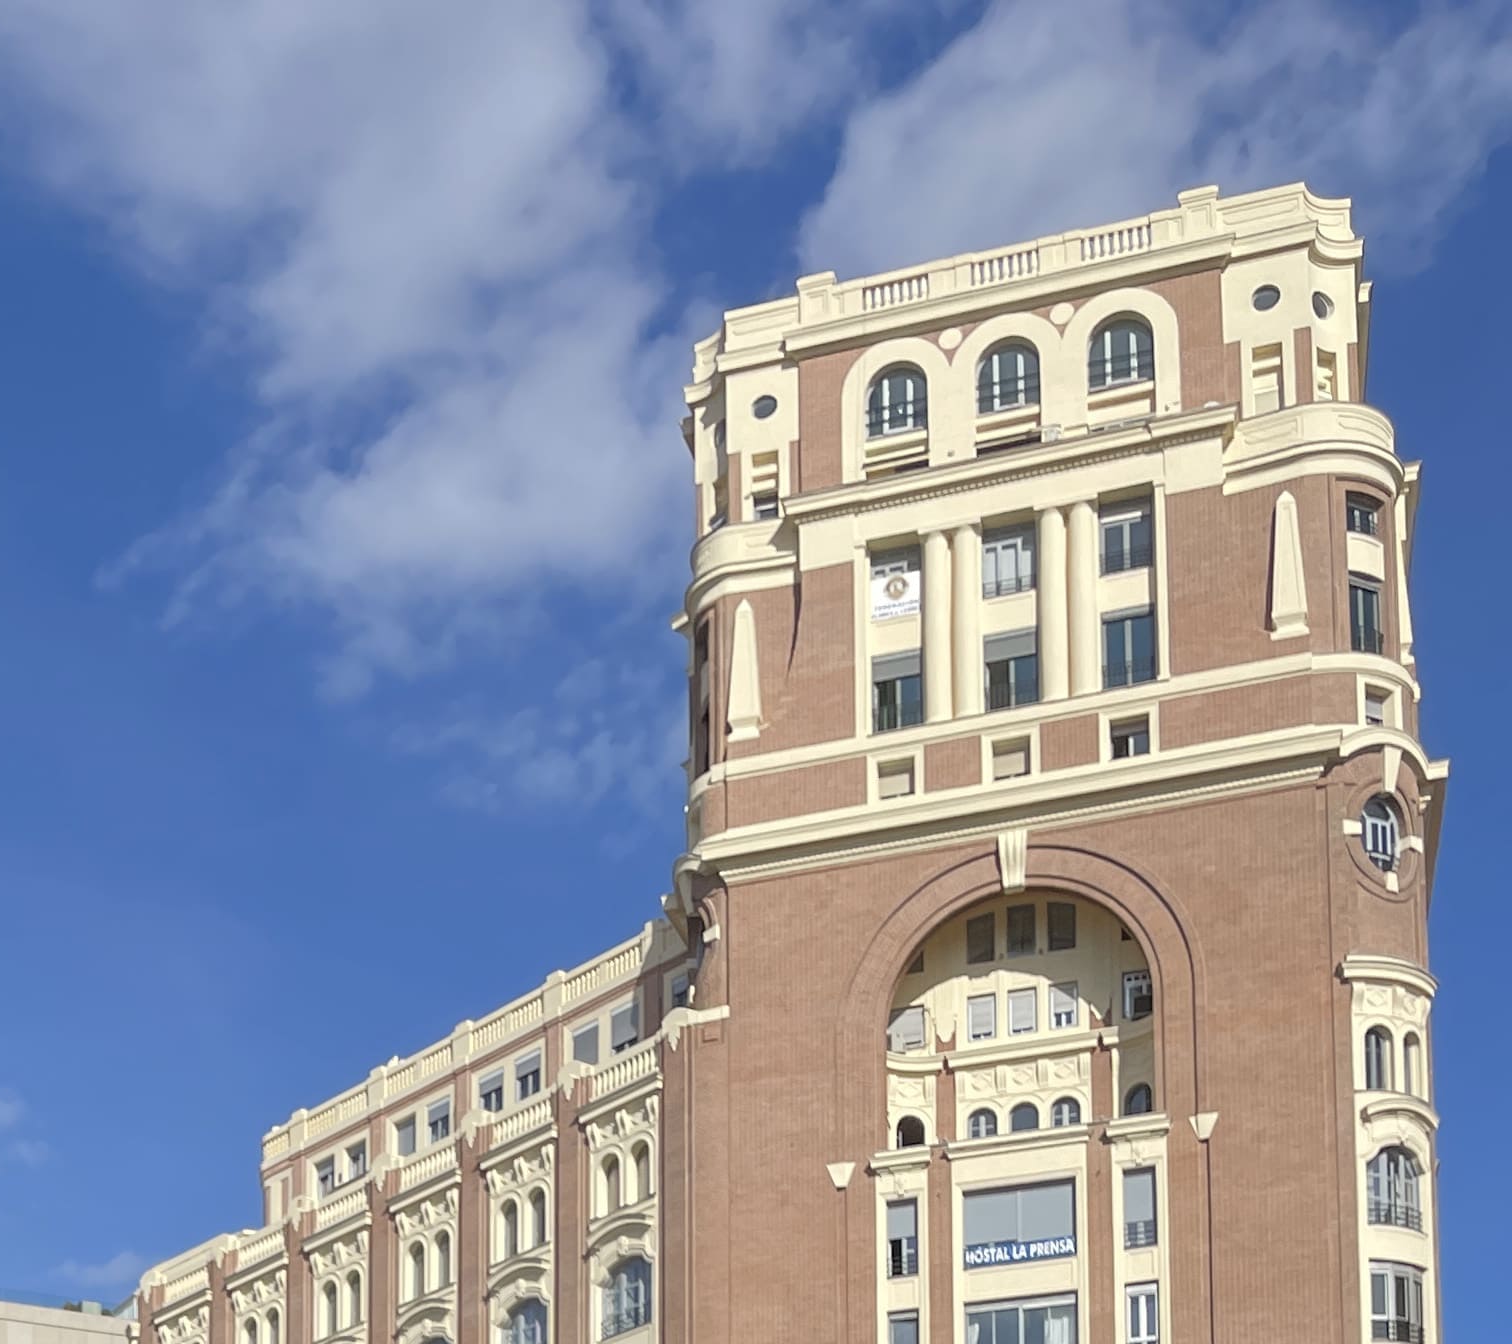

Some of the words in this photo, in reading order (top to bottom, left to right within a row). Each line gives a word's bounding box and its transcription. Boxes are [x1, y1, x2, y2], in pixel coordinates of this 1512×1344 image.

[966, 1247, 1010, 1264] HOSTAL
[1012, 1245, 1027, 1259] LA
[1030, 1239, 1075, 1257] PRENSA
